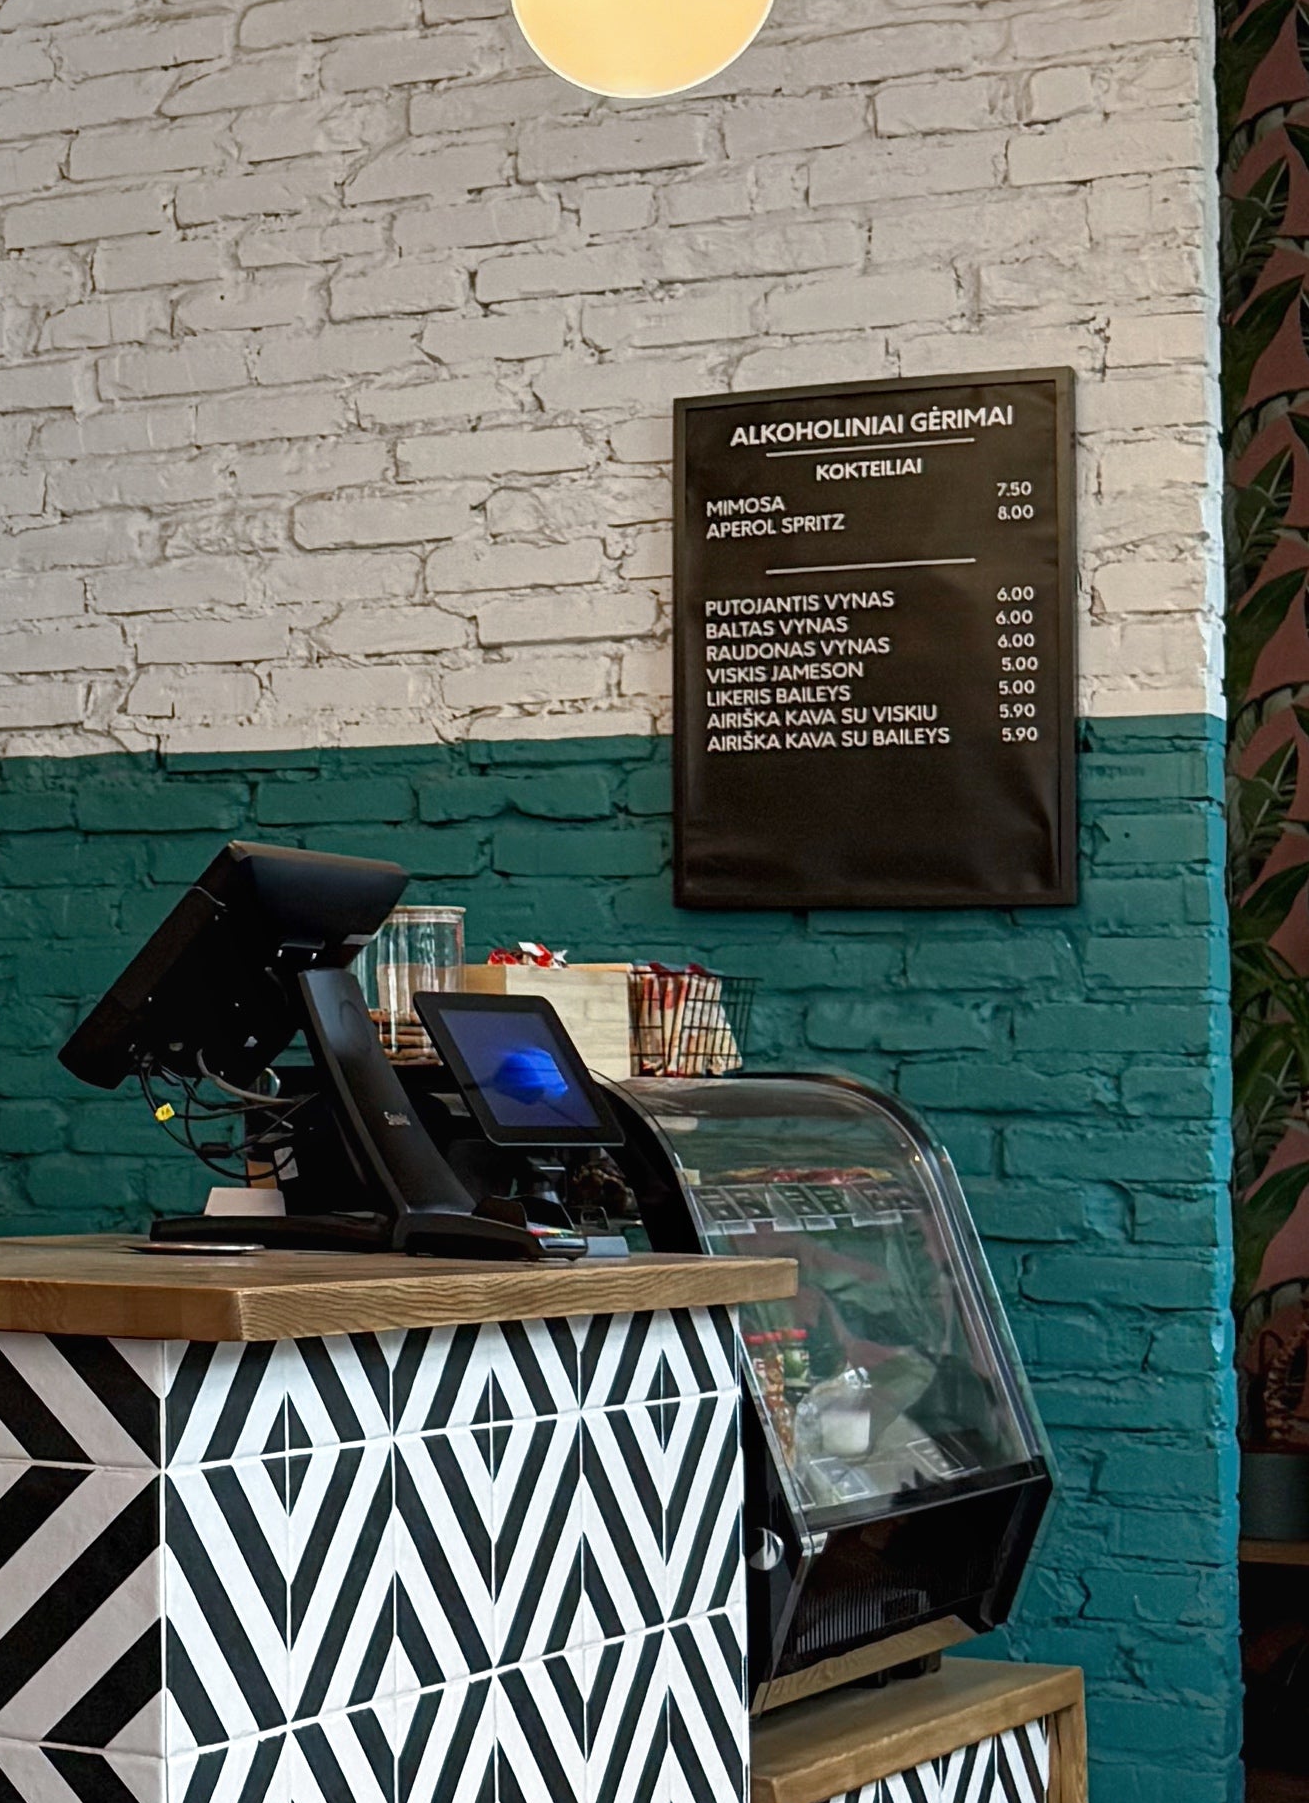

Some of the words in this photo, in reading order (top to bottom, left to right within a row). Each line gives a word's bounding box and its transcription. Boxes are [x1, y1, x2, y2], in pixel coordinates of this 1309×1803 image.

[730, 413, 904, 447] ALKOHOLINIAI
[910, 405, 1014, 432] GĖRIMAI
[815, 458, 922, 481] KOKTEILIAI
[996, 481, 1032, 497] 7.50
[706, 496, 785, 518] MIMOSA
[997, 504, 1034, 521] 8.00
[706, 519, 777, 540] APEROL
[781, 513, 846, 533] SPRITZ
[705, 594, 820, 617] PUTOJANTIS
[824, 590, 895, 610] VYNAS
[996, 586, 1035, 602] 6.00
[705, 618, 775, 639] BALTAS
[778, 615, 849, 635] VYNAS
[995, 609, 1034, 625] 6.00
[705, 640, 816, 662] RAUDONAS
[820, 636, 891, 656] VYNAS
[997, 633, 1035, 649] 6.00
[706, 665, 767, 684] VISKIS
[770, 661, 864, 682] JAMESON
[1001, 656, 1039, 672] 5.00
[706, 687, 771, 708] LIKERIS
[775, 685, 851, 705] BAILEYS
[998, 679, 1035, 695] 5.00
[706, 708, 781, 730] AIRIŠKA
[784, 707, 837, 727] KAVA
[841, 706, 868, 725] SU
[872, 703, 938, 723] VISKIU
[999, 702, 1036, 719] 5.90
[706, 730, 782, 753] AIRIŠKA
[784, 729, 837, 750] KAVA
[841, 729, 868, 748] SU
[872, 727, 951, 747] BAILEYS
[1001, 726, 1038, 742] 5.90
